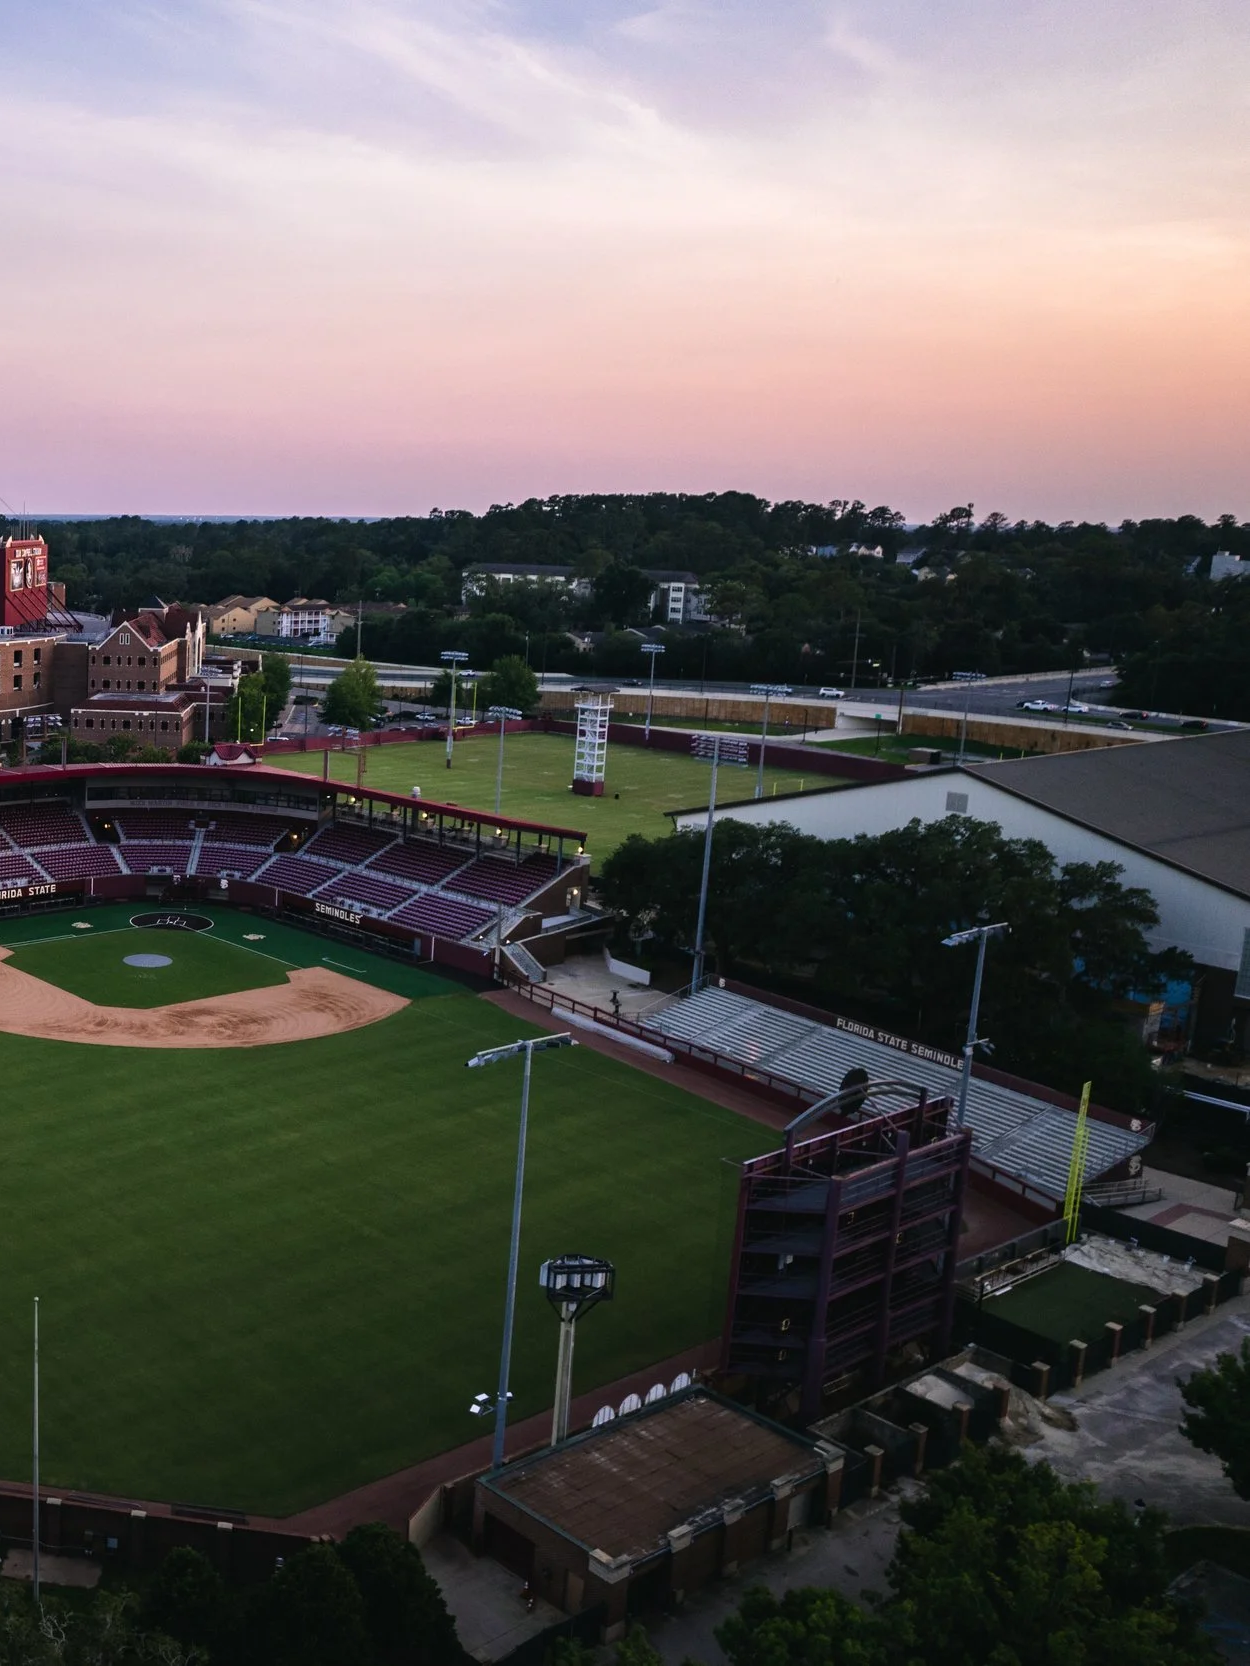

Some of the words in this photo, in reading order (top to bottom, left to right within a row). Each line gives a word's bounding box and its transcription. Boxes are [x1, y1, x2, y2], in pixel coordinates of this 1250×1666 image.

[29, 884, 56, 896] STATE
[315, 902, 361, 924] SEMINOLES
[836, 1018, 875, 1039] FLORIDA
[877, 1032, 908, 1051] STATE
[911, 1043, 964, 1069] SEMINOLE
